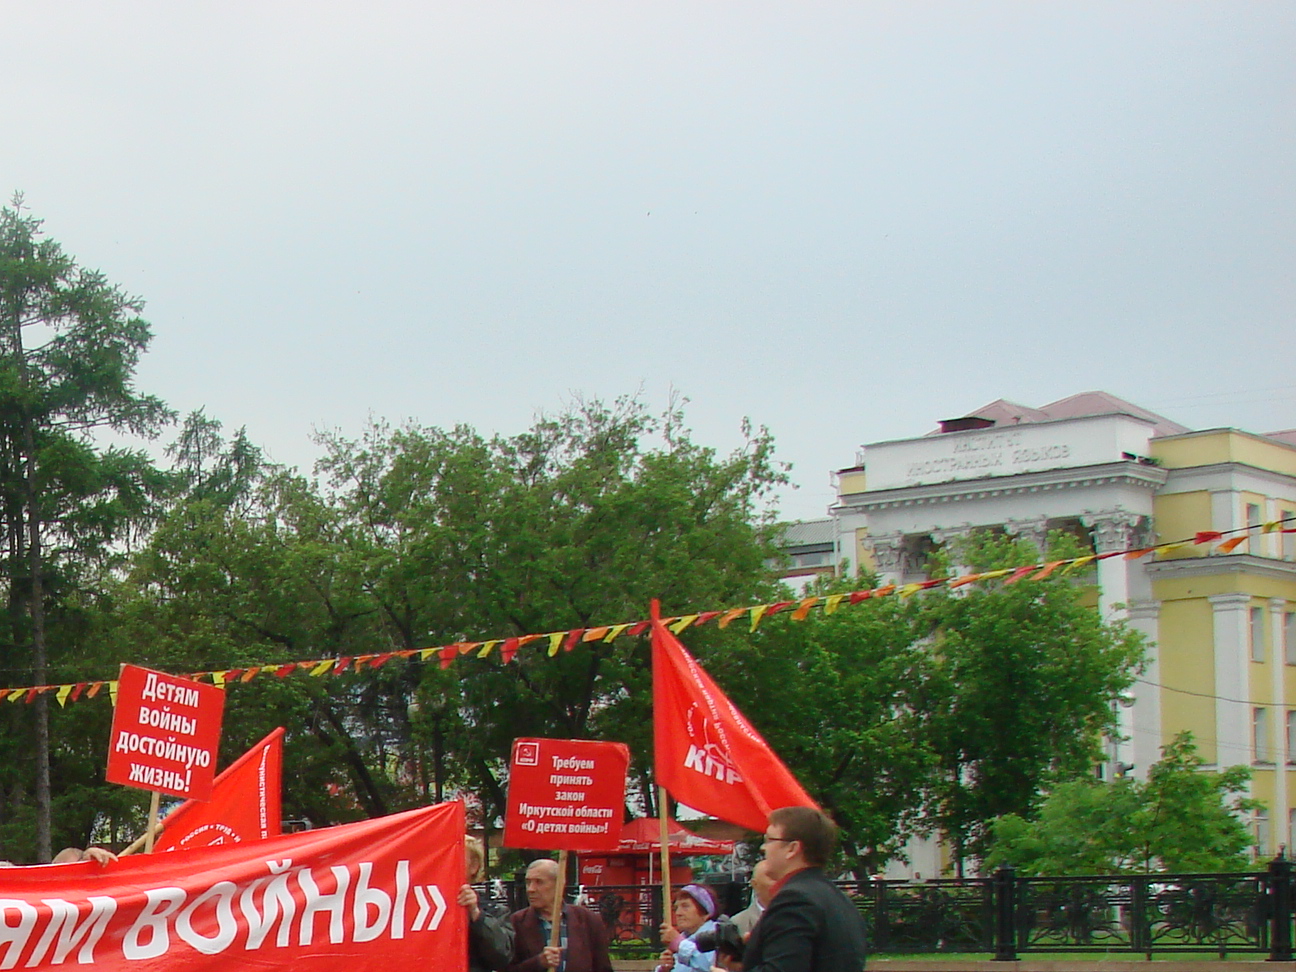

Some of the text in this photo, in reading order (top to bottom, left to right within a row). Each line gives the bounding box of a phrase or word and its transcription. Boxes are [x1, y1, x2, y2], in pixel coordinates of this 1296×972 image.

[142, 673, 199, 708] Детям
[139, 705, 197, 736] войны
[115, 731, 210, 770] достойную
[552, 755, 595, 771] Требуем
[684, 744, 744, 785] КПР
[129, 763, 192, 793] жизнь!
[549, 774, 593, 787] принять
[519, 803, 613, 818] Иркутской области
[554, 791, 585, 801] закон
[521, 820, 609, 834] «О детях войны»!
[122, 858, 448, 961] ВОЙНЫ»
